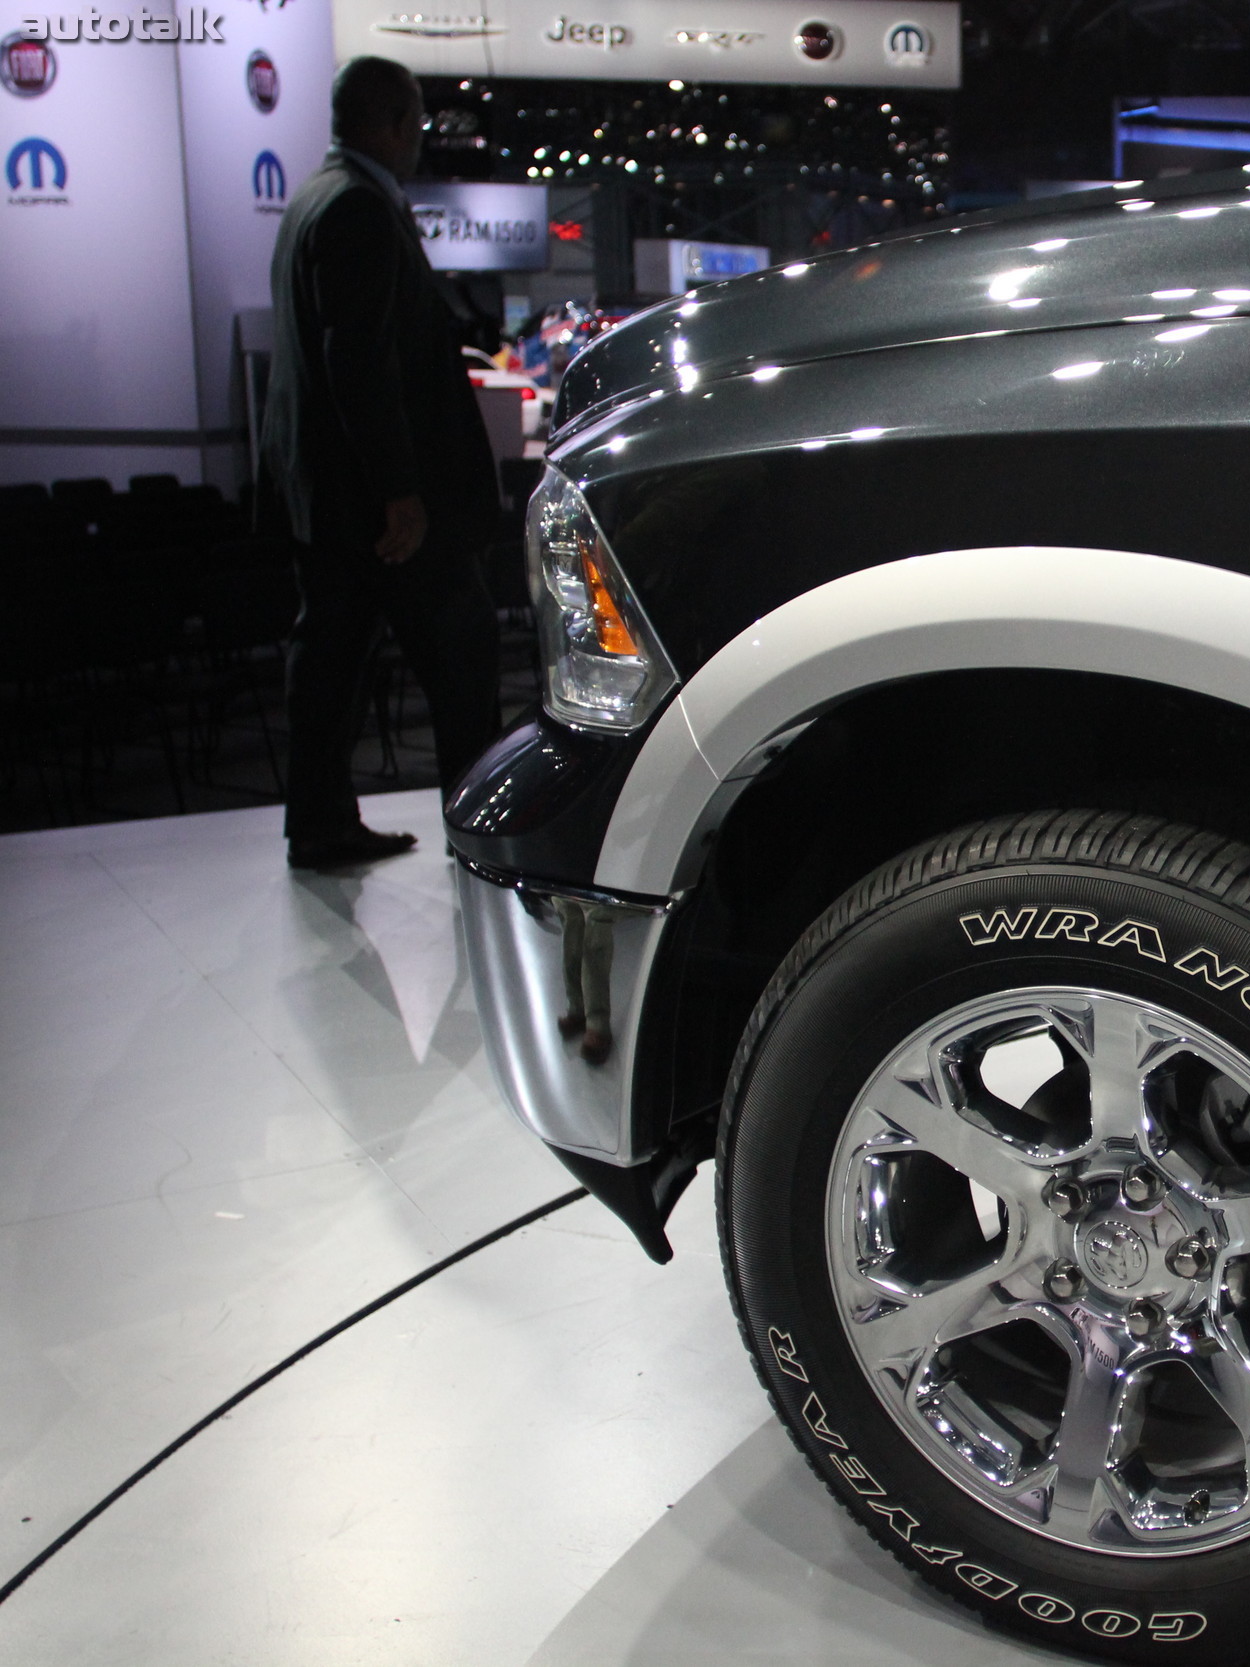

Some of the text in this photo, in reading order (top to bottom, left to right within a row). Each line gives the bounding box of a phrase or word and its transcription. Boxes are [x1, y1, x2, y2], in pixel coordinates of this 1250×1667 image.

[547, 15, 627, 48] Jeep
[449, 219, 492, 242] RAM
[494, 220, 537, 243] 1500
[768, 1326, 1207, 1640] GOODYEAR
